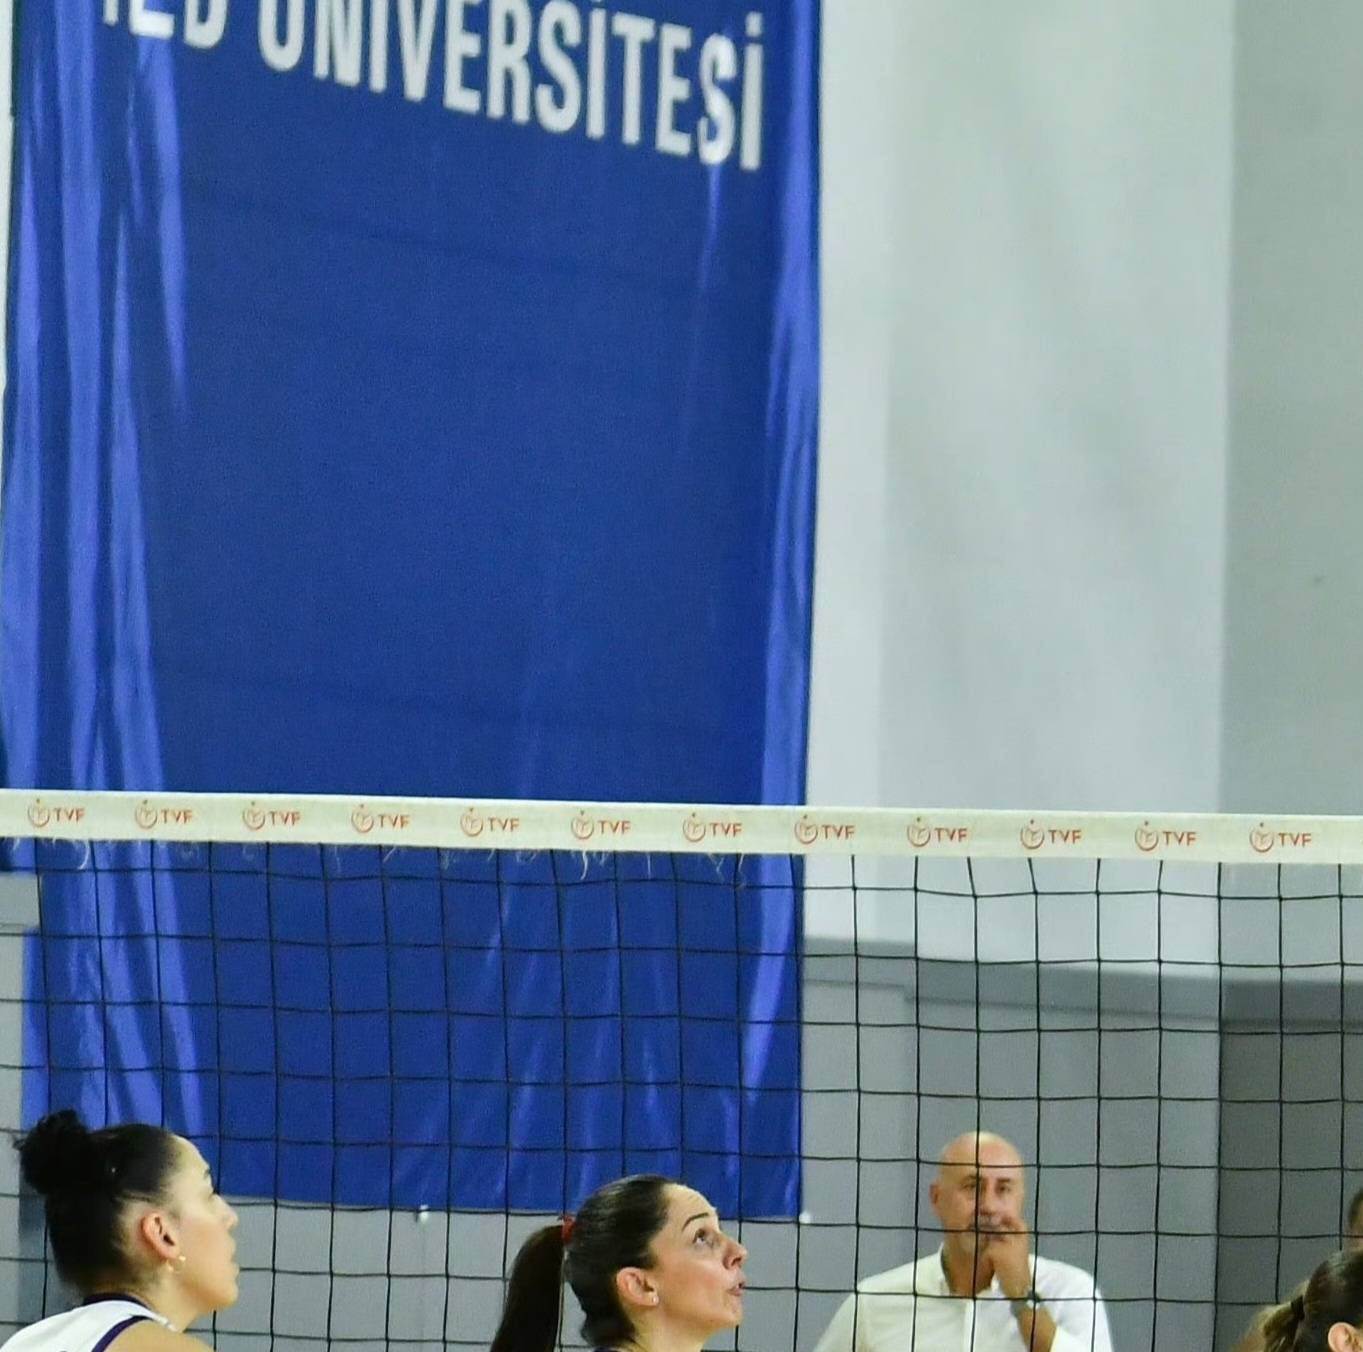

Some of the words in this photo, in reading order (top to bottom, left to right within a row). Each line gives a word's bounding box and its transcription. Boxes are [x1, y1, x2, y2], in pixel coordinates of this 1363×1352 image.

[52, 807, 85, 823] TVF
[160, 808, 193, 825] TVF
[268, 810, 301, 826] TVF
[377, 813, 410, 829] TVF
[487, 816, 520, 833] TVF
[597, 819, 631, 835] TVF
[708, 822, 743, 838] TVF
[820, 823, 855, 840] TVF
[933, 827, 968, 843] TVF
[1047, 828, 1082, 845] TVF
[1161, 830, 1197, 847] TVF
[1276, 832, 1312, 848] TVF
